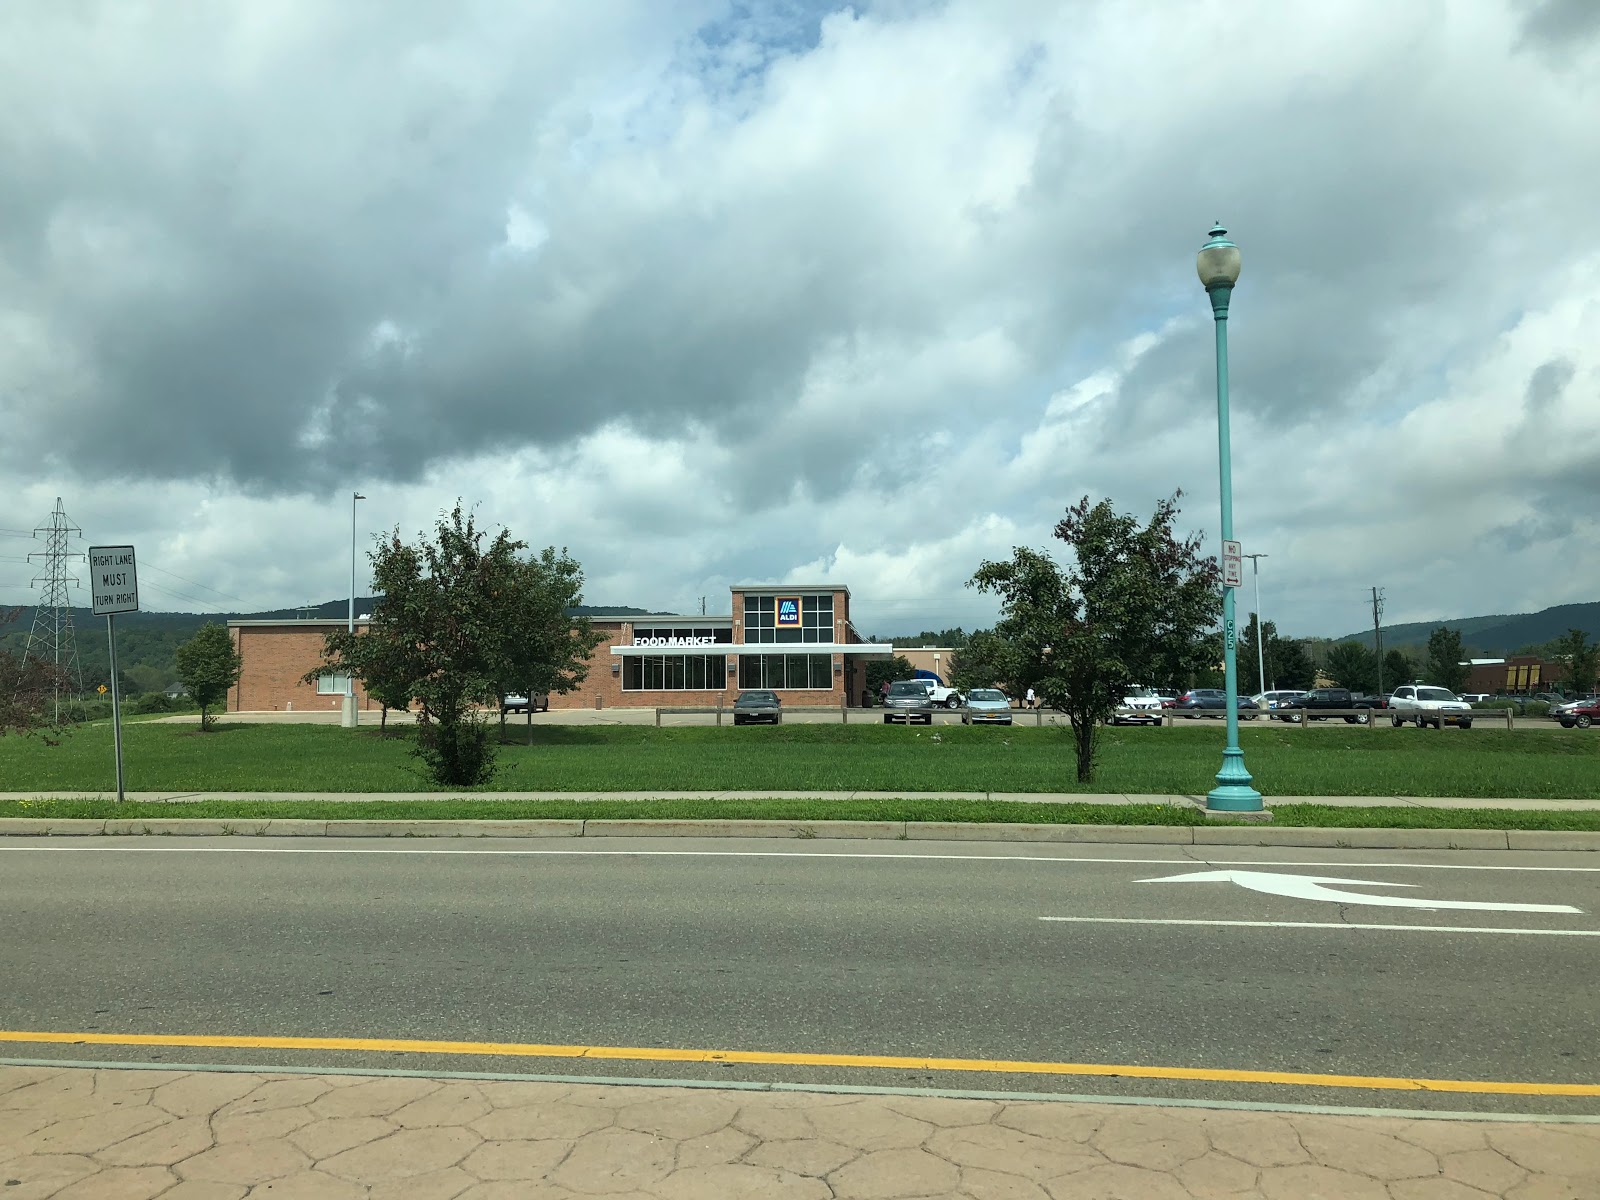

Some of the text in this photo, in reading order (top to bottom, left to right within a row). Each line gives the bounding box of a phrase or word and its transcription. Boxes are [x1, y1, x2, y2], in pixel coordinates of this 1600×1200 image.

[1228, 545, 1236, 554] NO
[93, 554, 132, 566] RIGHT LANE
[103, 573, 126, 586] MUST
[95, 592, 135, 606] TURN RIGHT
[634, 636, 716, 646] FOOD MARKET
